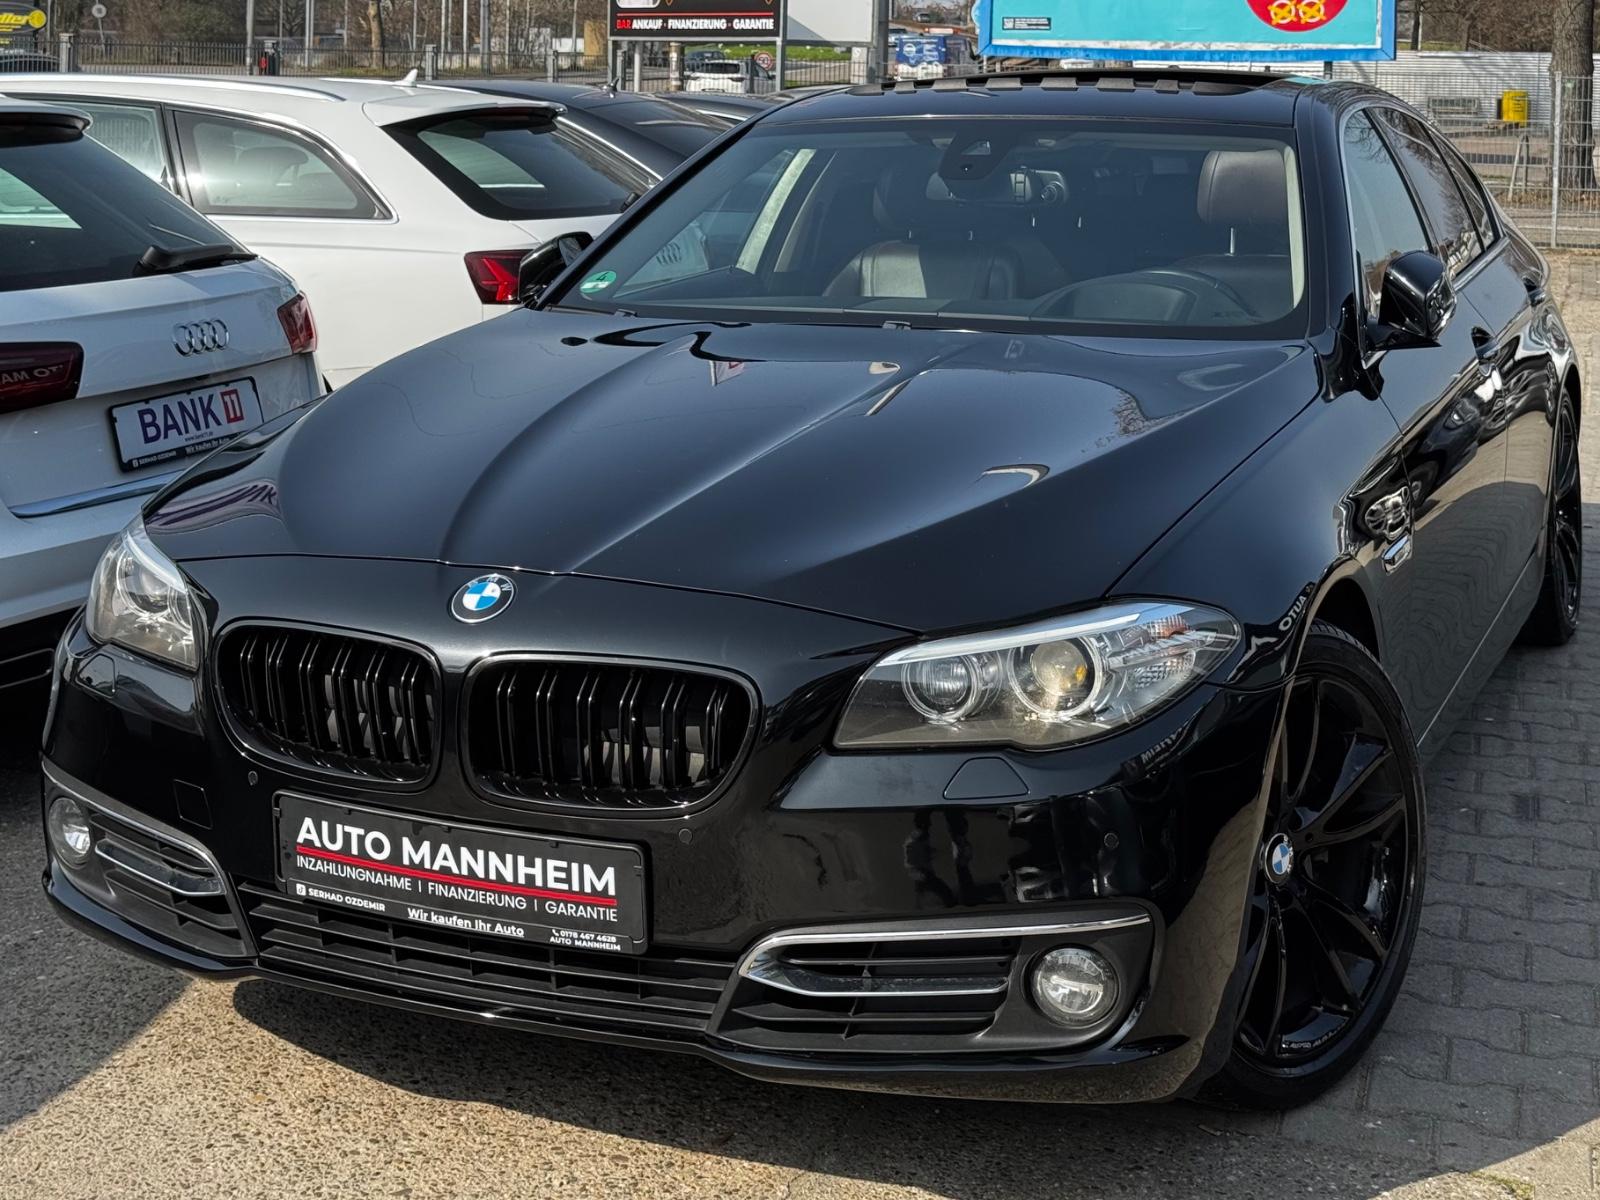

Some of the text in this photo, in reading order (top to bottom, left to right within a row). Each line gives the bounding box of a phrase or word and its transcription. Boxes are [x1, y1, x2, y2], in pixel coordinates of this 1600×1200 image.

[632, 19, 663, 30] ANKAUF
[667, 19, 727, 30] FINANZIERUNG
[732, 18, 774, 30] GARANTIE
[137, 391, 242, 444] BANK 11
[296, 816, 617, 896] AUTO MANNHEIM
[296, 855, 618, 923] INZAHLUNGNAHME FINANZIERUNG GARANTIE
[308, 887, 386, 912] SERHAD OZDEMIR
[407, 907, 525, 937] Wir kaufen Ihr Auto
[549, 936, 621, 951] AUTO MANNHEIM
